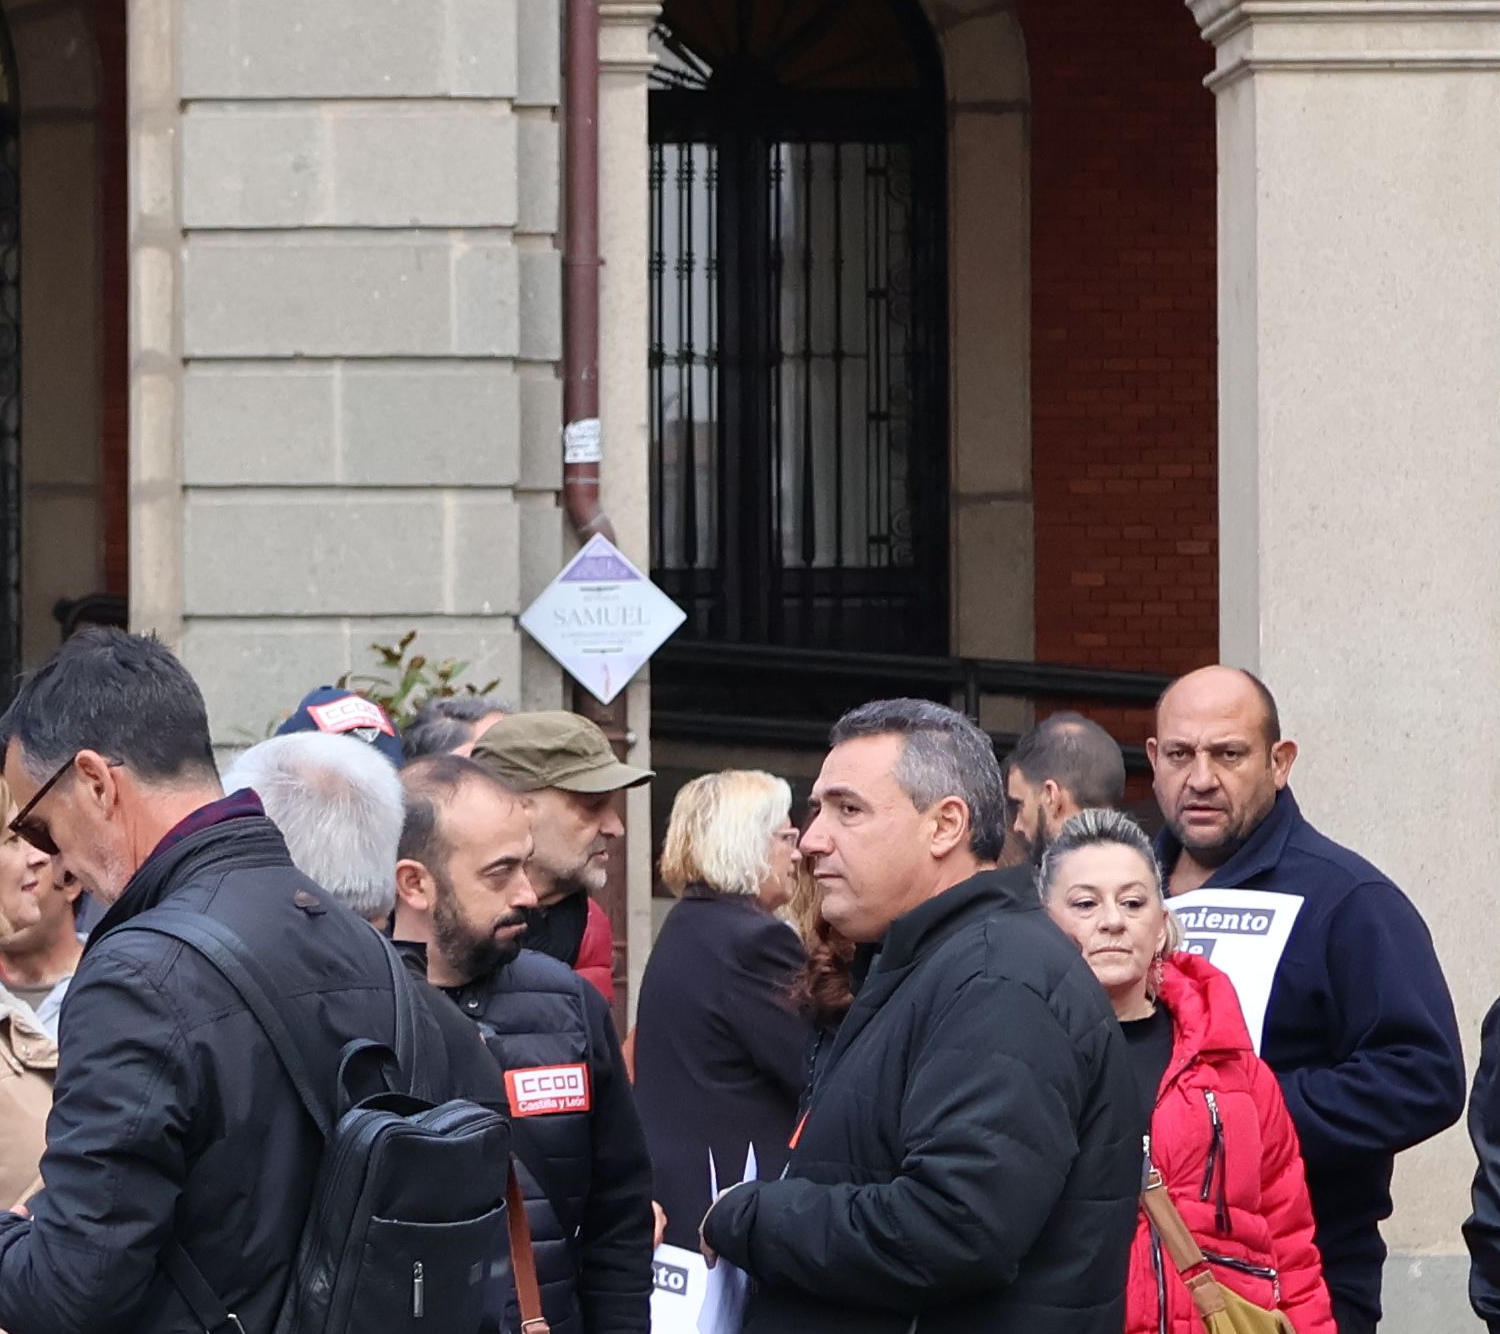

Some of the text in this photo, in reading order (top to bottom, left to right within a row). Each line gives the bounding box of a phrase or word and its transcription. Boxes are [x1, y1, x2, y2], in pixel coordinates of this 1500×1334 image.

[553, 605, 650, 627] SAMUEL
[521, 1074, 579, 1094] CCOO
[518, 1097, 586, 1113] Castilla y León
